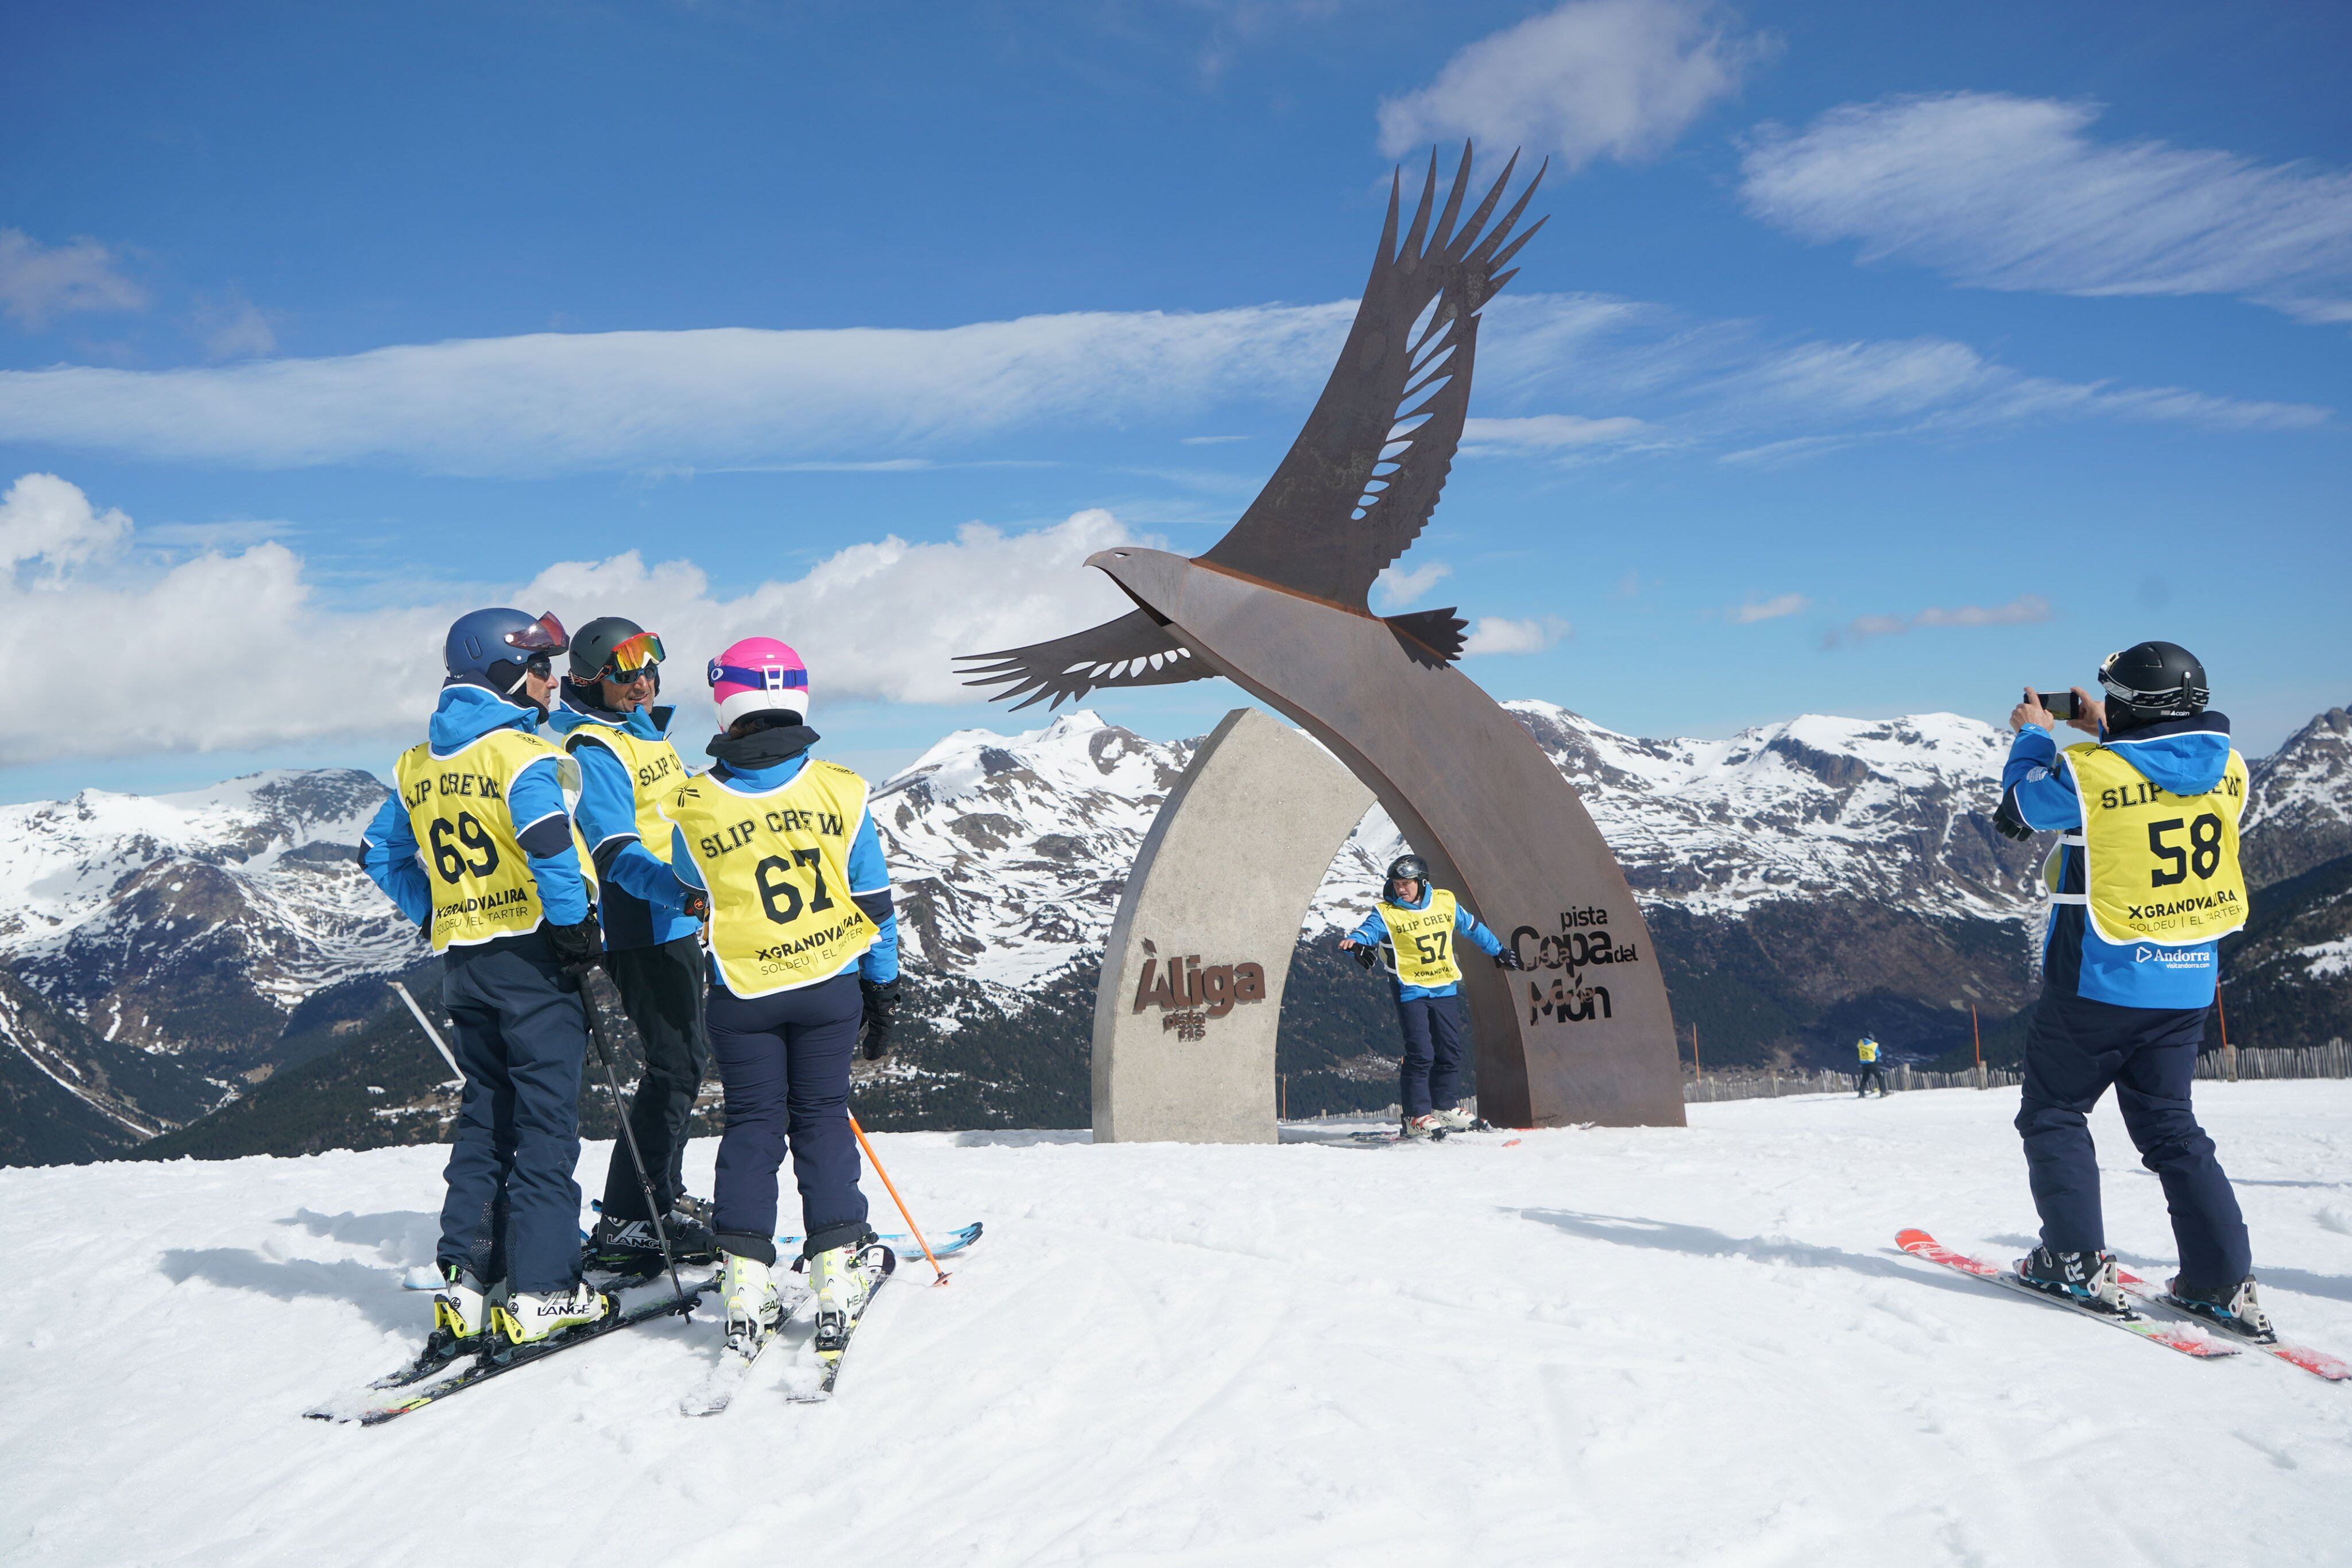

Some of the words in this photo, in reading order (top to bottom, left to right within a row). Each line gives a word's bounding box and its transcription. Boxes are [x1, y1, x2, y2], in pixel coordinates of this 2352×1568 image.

[439, 772, 502, 800] CREW
[639, 756, 671, 788] SLIP
[2101, 781, 2164, 810] SLIP
[430, 811, 500, 884] 69
[700, 819, 757, 860] SLIP
[764, 808, 844, 837] CREW
[2148, 813, 2222, 888] 58
[755, 847, 834, 925] 67
[437, 918, 462, 935] SOLDEU
[471, 916, 483, 927] EL
[487, 907, 528, 922] TARTER
[1560, 906, 1607, 932] pista
[2190, 916, 2204, 926] EL
[761, 956, 810, 975] SOLDEU
[822, 948, 838, 959] EL
[1415, 931, 1447, 965] 57
[1511, 925, 1614, 978] Copa
[1614, 944, 1638, 963] del
[2154, 949, 2210, 962] Andorra
[1526, 973, 1612, 1026] Món
[537, 1304, 590, 1317] LANGE
